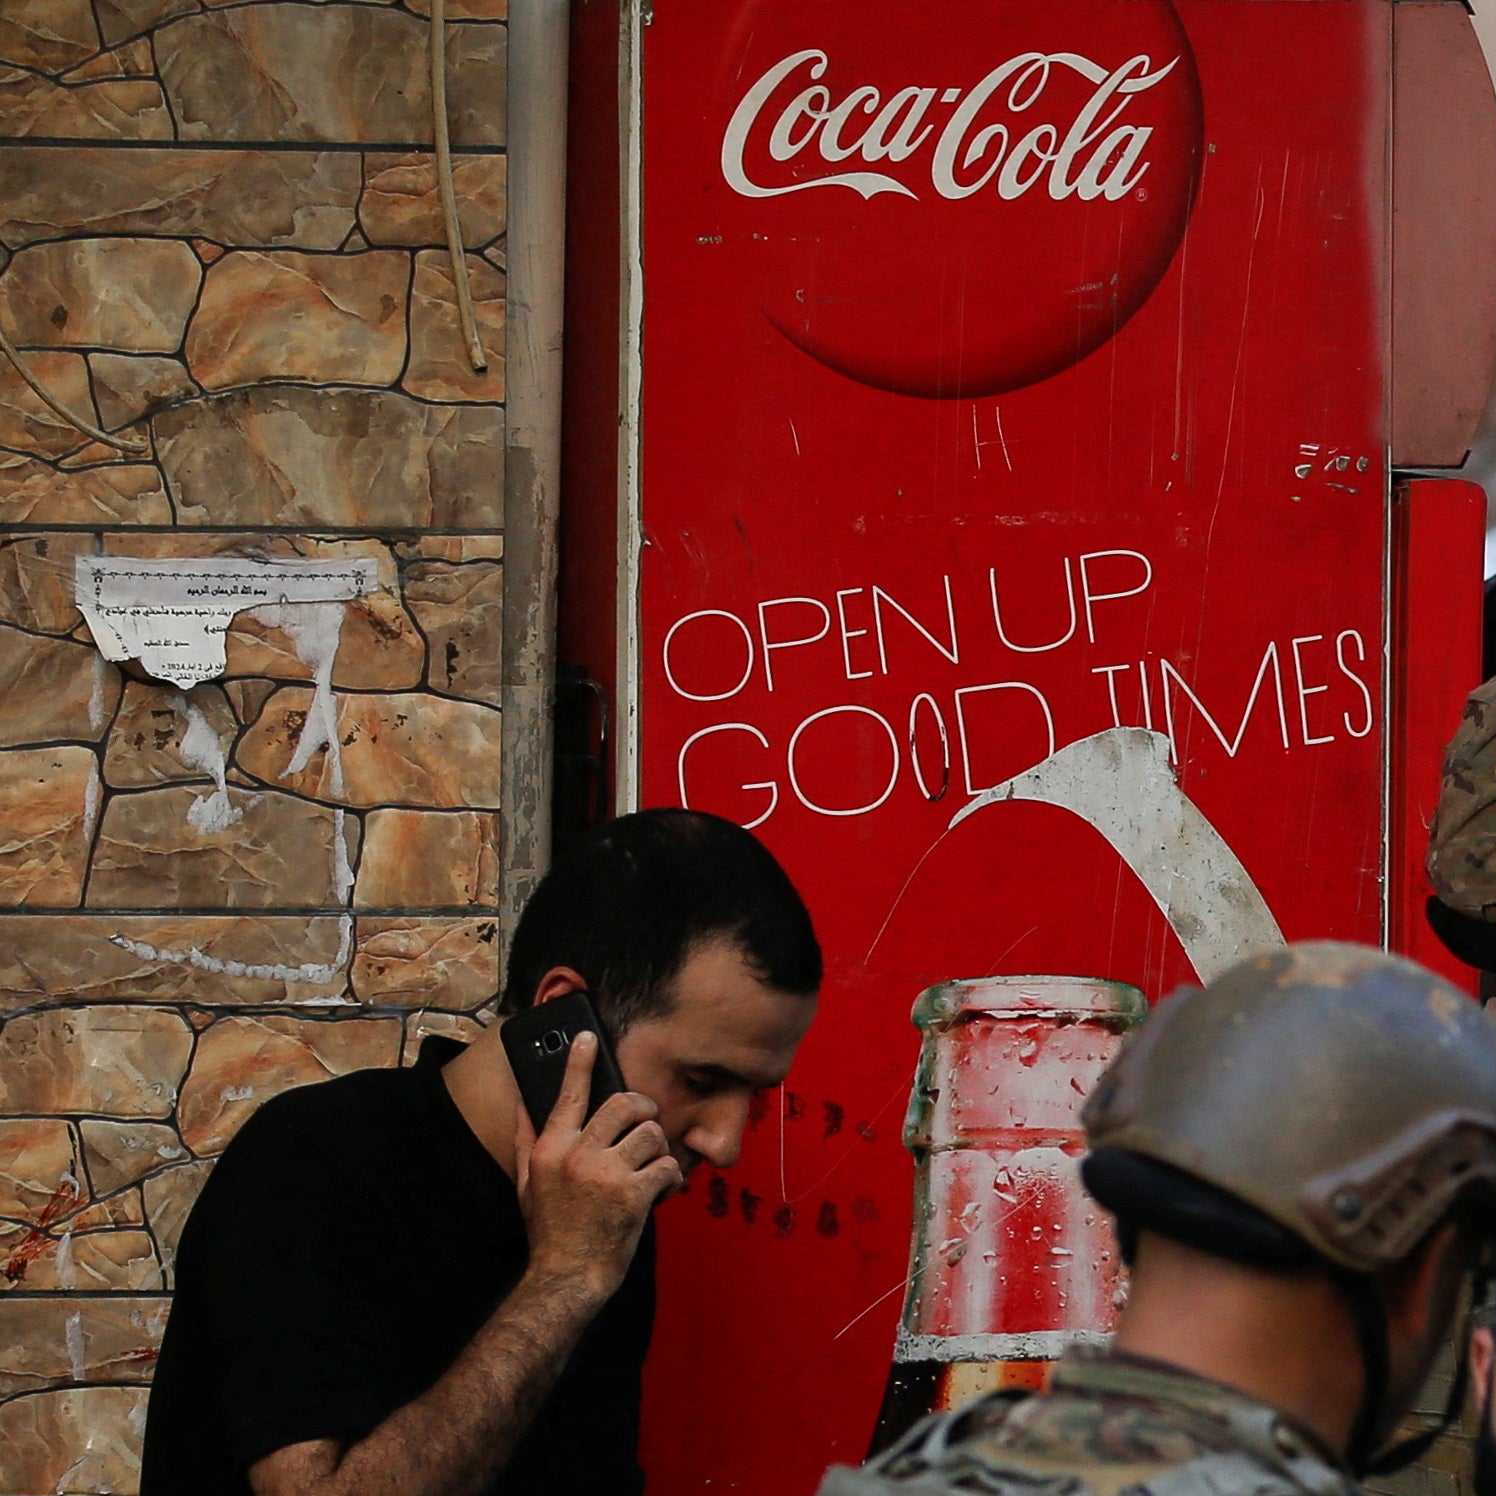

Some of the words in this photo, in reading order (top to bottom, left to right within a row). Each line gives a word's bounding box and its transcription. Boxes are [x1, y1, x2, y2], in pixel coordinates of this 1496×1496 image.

[721, 48, 1180, 201] Coca-Cola
[663, 573, 959, 702] OPEN
[989, 549, 1152, 653] UP
[677, 682, 1055, 831] GOOD
[1091, 629, 1374, 766] TIMES
